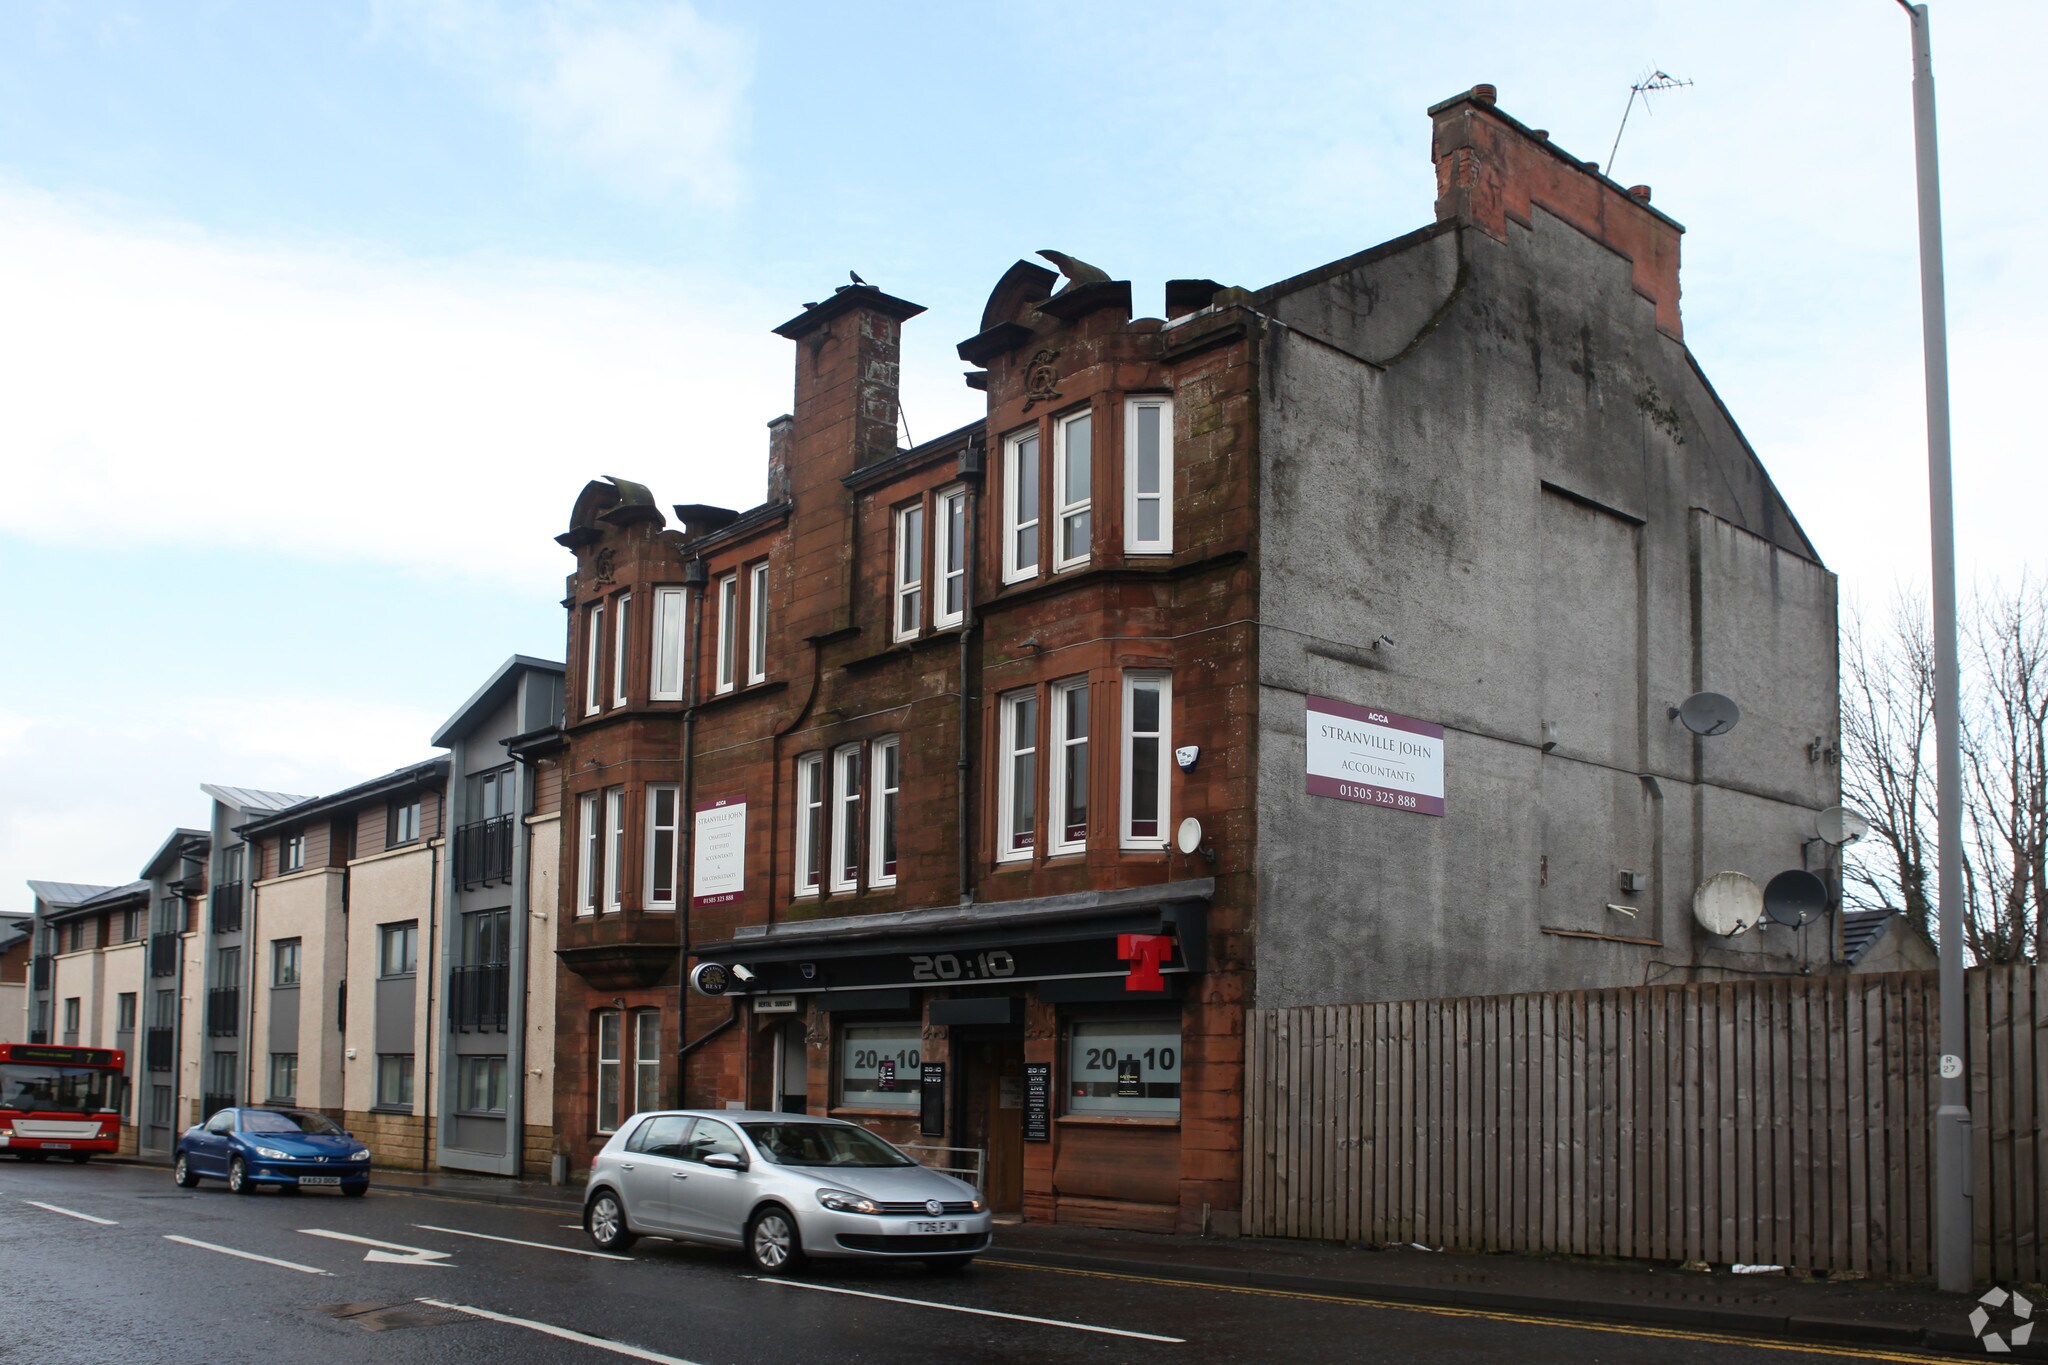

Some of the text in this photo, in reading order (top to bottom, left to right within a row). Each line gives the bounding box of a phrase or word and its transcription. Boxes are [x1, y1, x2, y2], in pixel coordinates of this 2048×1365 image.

[1368, 712, 1389, 724] ACCA
[1321, 725, 1431, 759] STRANVILLE JOHN
[1341, 760, 1416, 783] ACCOUNTANTS
[1339, 784, 1416, 808] 01505 325 888
[697, 811, 743, 825] STRANVILLE JOHN
[708, 832, 731, 841] CHARTERED
[705, 853, 734, 861] ACCOUNTANTS
[709, 873, 736, 881] CONSULTANTS
[908, 950, 1016, 981] 20:10
[86, 1053, 93, 1064] 7
